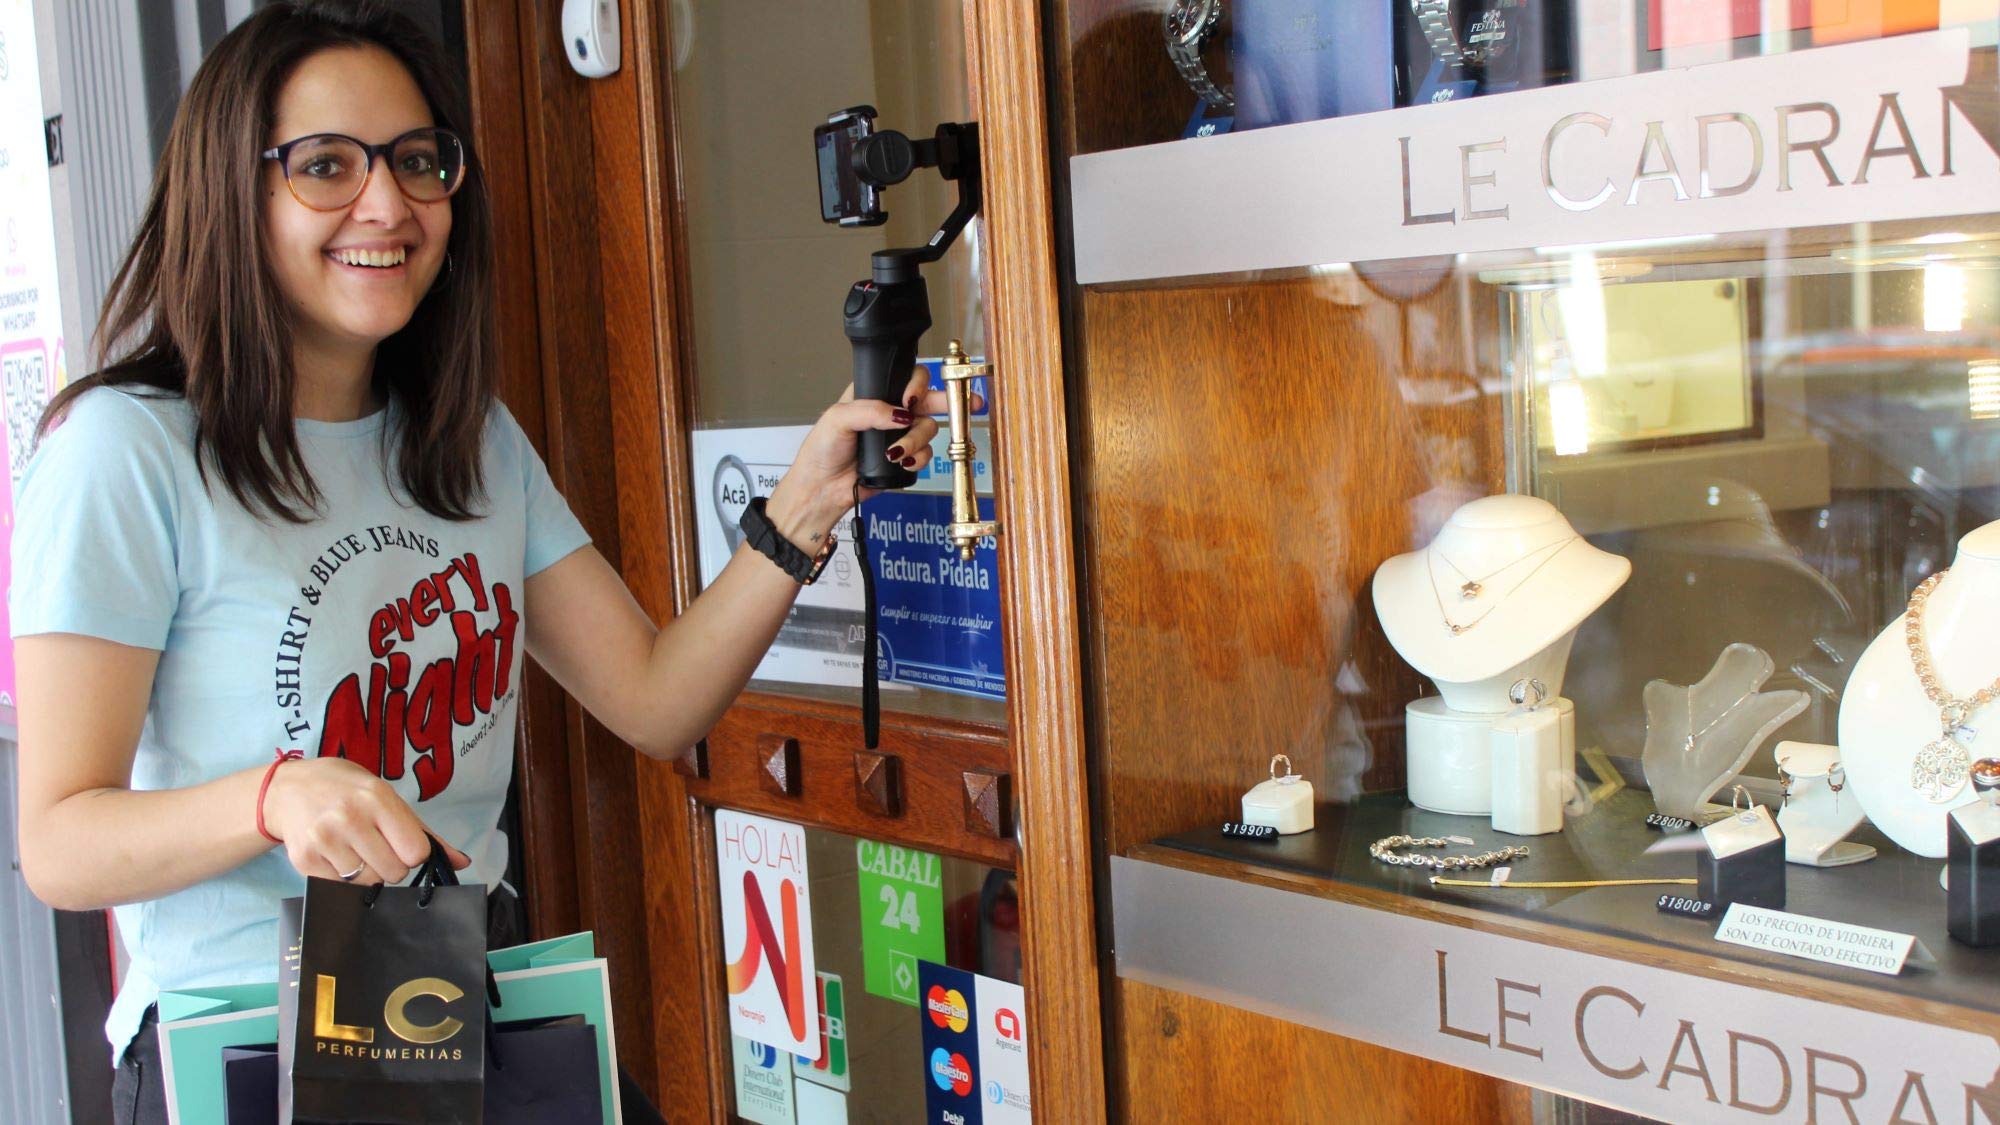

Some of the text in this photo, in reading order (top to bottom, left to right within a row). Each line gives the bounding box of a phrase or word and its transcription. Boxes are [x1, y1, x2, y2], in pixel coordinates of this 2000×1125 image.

[1399, 135, 1510, 226] LE
[722, 484, 746, 504] Acá
[869, 513, 902, 547] Aquí
[905, 518, 997, 553] entregos
[880, 551, 989, 591] factura. Pídala
[369, 553, 489, 658] every
[880, 605, 993, 631] Cumplir es empezar a cambiar
[275, 525, 439, 741] T-SHIRT & BLUE JEANS
[318, 583, 519, 802] Night
[724, 820, 801, 874] HOLA!
[857, 838, 939, 888] CABAL
[880, 884, 921, 934] 24
[1739, 912, 1895, 952] LOS PRECIOS DE VIDRIERA
[1724, 926, 1897, 970] SON DE CONTADO EFECTIVO
[314, 974, 465, 1044] LC
[928, 998, 967, 1020] MasterCard
[1436, 949, 1544, 1062] LE
[317, 1041, 463, 1061] PERFUMERIAS
[935, 1062, 969, 1082] Maestro
